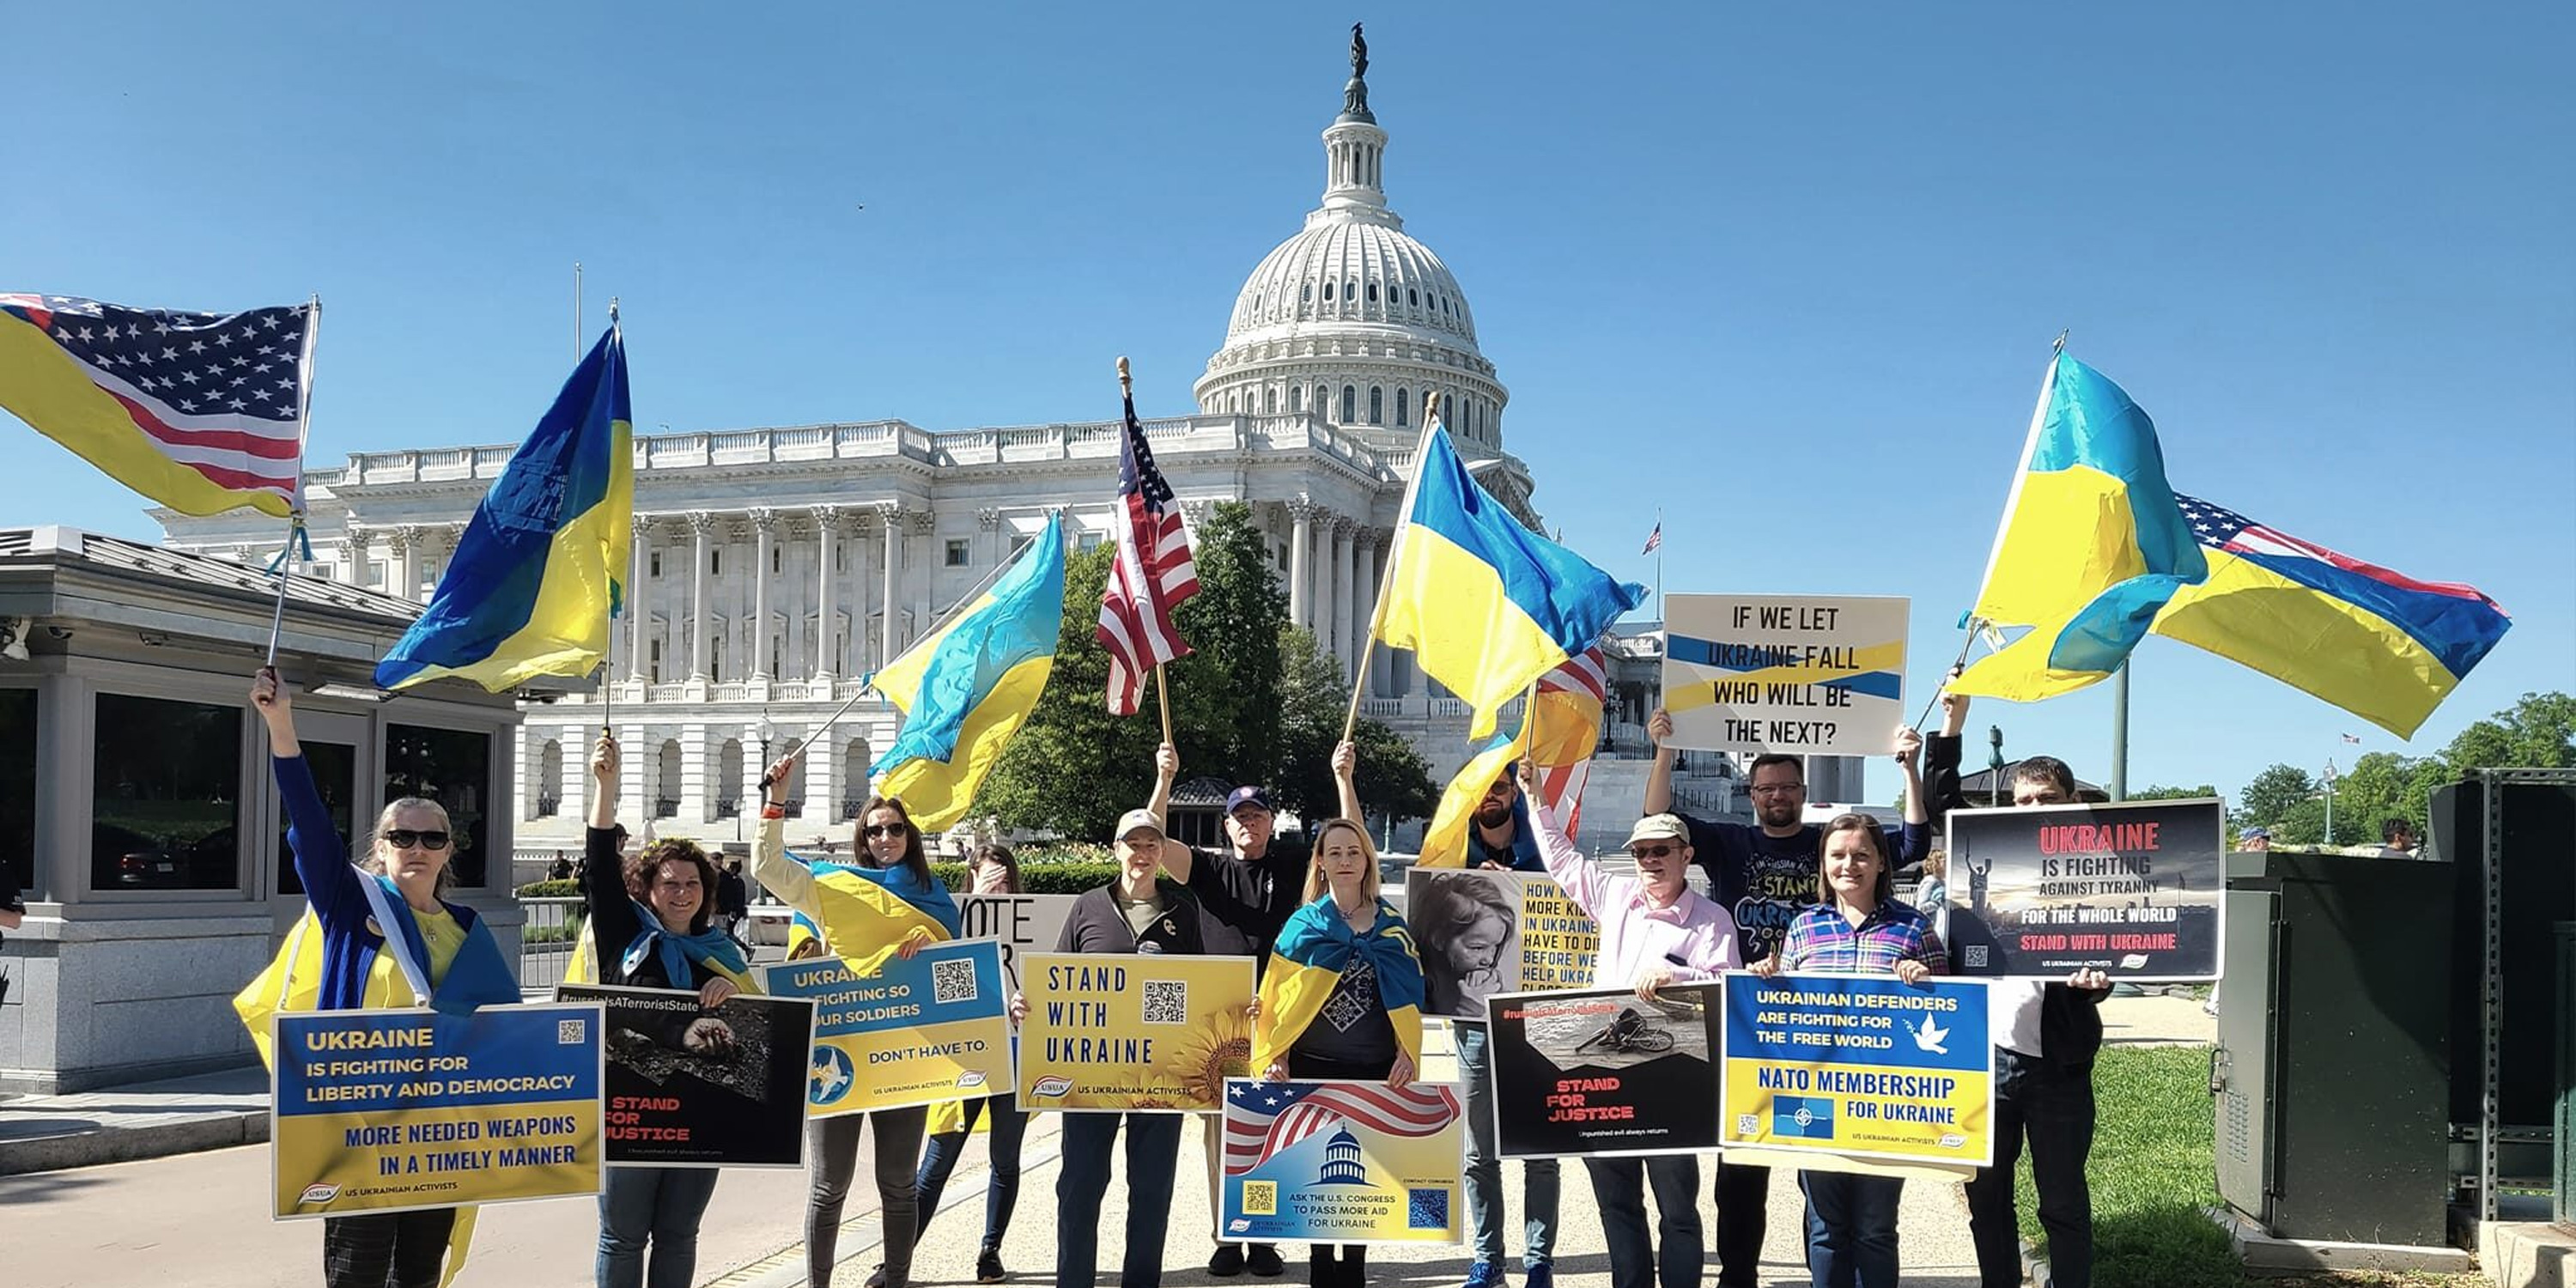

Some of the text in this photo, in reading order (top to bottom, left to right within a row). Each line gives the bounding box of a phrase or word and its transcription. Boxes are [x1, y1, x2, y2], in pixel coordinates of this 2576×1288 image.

[1733, 606, 1838, 630] IF WE LET
[1708, 643, 1859, 669] UKRAINE FALL
[1714, 681, 1852, 707] WHO WILL BE
[1725, 719, 1837, 744] THE NEXT?
[2039, 822, 2160, 854] UKRAINE
[2042, 856, 2151, 877] IS FIGHTING
[1527, 884, 1555, 898] HOW
[2039, 880, 2159, 896] AGAINST TYRANNY
[1526, 901, 1561, 915] MORE
[2021, 908, 2177, 924] FOR THE WHOLE WORLD
[1525, 918, 1597, 933] IN UKRAINE
[1524, 934, 1558, 949] HAVE
[1564, 936, 1579, 950] TO
[2020, 933, 2177, 951] STAND WITH UKRAINE
[1523, 950, 1598, 968] BEFORE WE
[794, 969, 883, 987] UKRAIE
[1048, 966, 1126, 992] STAND
[1522, 967, 1555, 981] HELP
[815, 985, 911, 1006] FIGHTING SO
[1757, 990, 1958, 1012] UKRAINIAN DEFENDERS
[846, 1004, 920, 1023] SOLDIERS
[1048, 1002, 1107, 1027] WITH
[1757, 1012, 1892, 1029] ARE FIGHTING FOR
[307, 1028, 433, 1051] UKRAINE
[1757, 1030, 1893, 1048] THE FREE WORLD
[869, 1040, 988, 1064] DON'T HAVE TO.
[1047, 1037, 1152, 1064] UKRAINE
[307, 1056, 468, 1078] IS FIGHTING FOR
[307, 1075, 575, 1103] LIBERTY AND DEMOCRACY
[1093, 1086, 1144, 1095] UKRAINIAN
[1146, 1087, 1192, 1096] ACTIVISTS
[1557, 1078, 1620, 1092] STAND
[1759, 1067, 1955, 1099] NATO MEMBERSHIP
[612, 1096, 680, 1110] STAND
[1546, 1094, 1585, 1108] FOR
[1548, 1106, 1634, 1122] JUSTICE
[1847, 1101, 1955, 1124] FOR UKRAINE
[346, 1115, 576, 1147] MORE NEEDED WEAPONS
[379, 1145, 576, 1176] IN A TIMELY MANNER
[361, 1186, 410, 1195] UKRAINIAN
[413, 1182, 458, 1192] ACTIVISTS
[1290, 1194, 1308, 1202] ASK
[1309, 1194, 1325, 1202] THE
[1346, 1194, 1396, 1203] CONGRESS
[1294, 1205, 1388, 1215] TO PASS MORE AID
[1308, 1218, 1376, 1229] FOR UKRAINE
